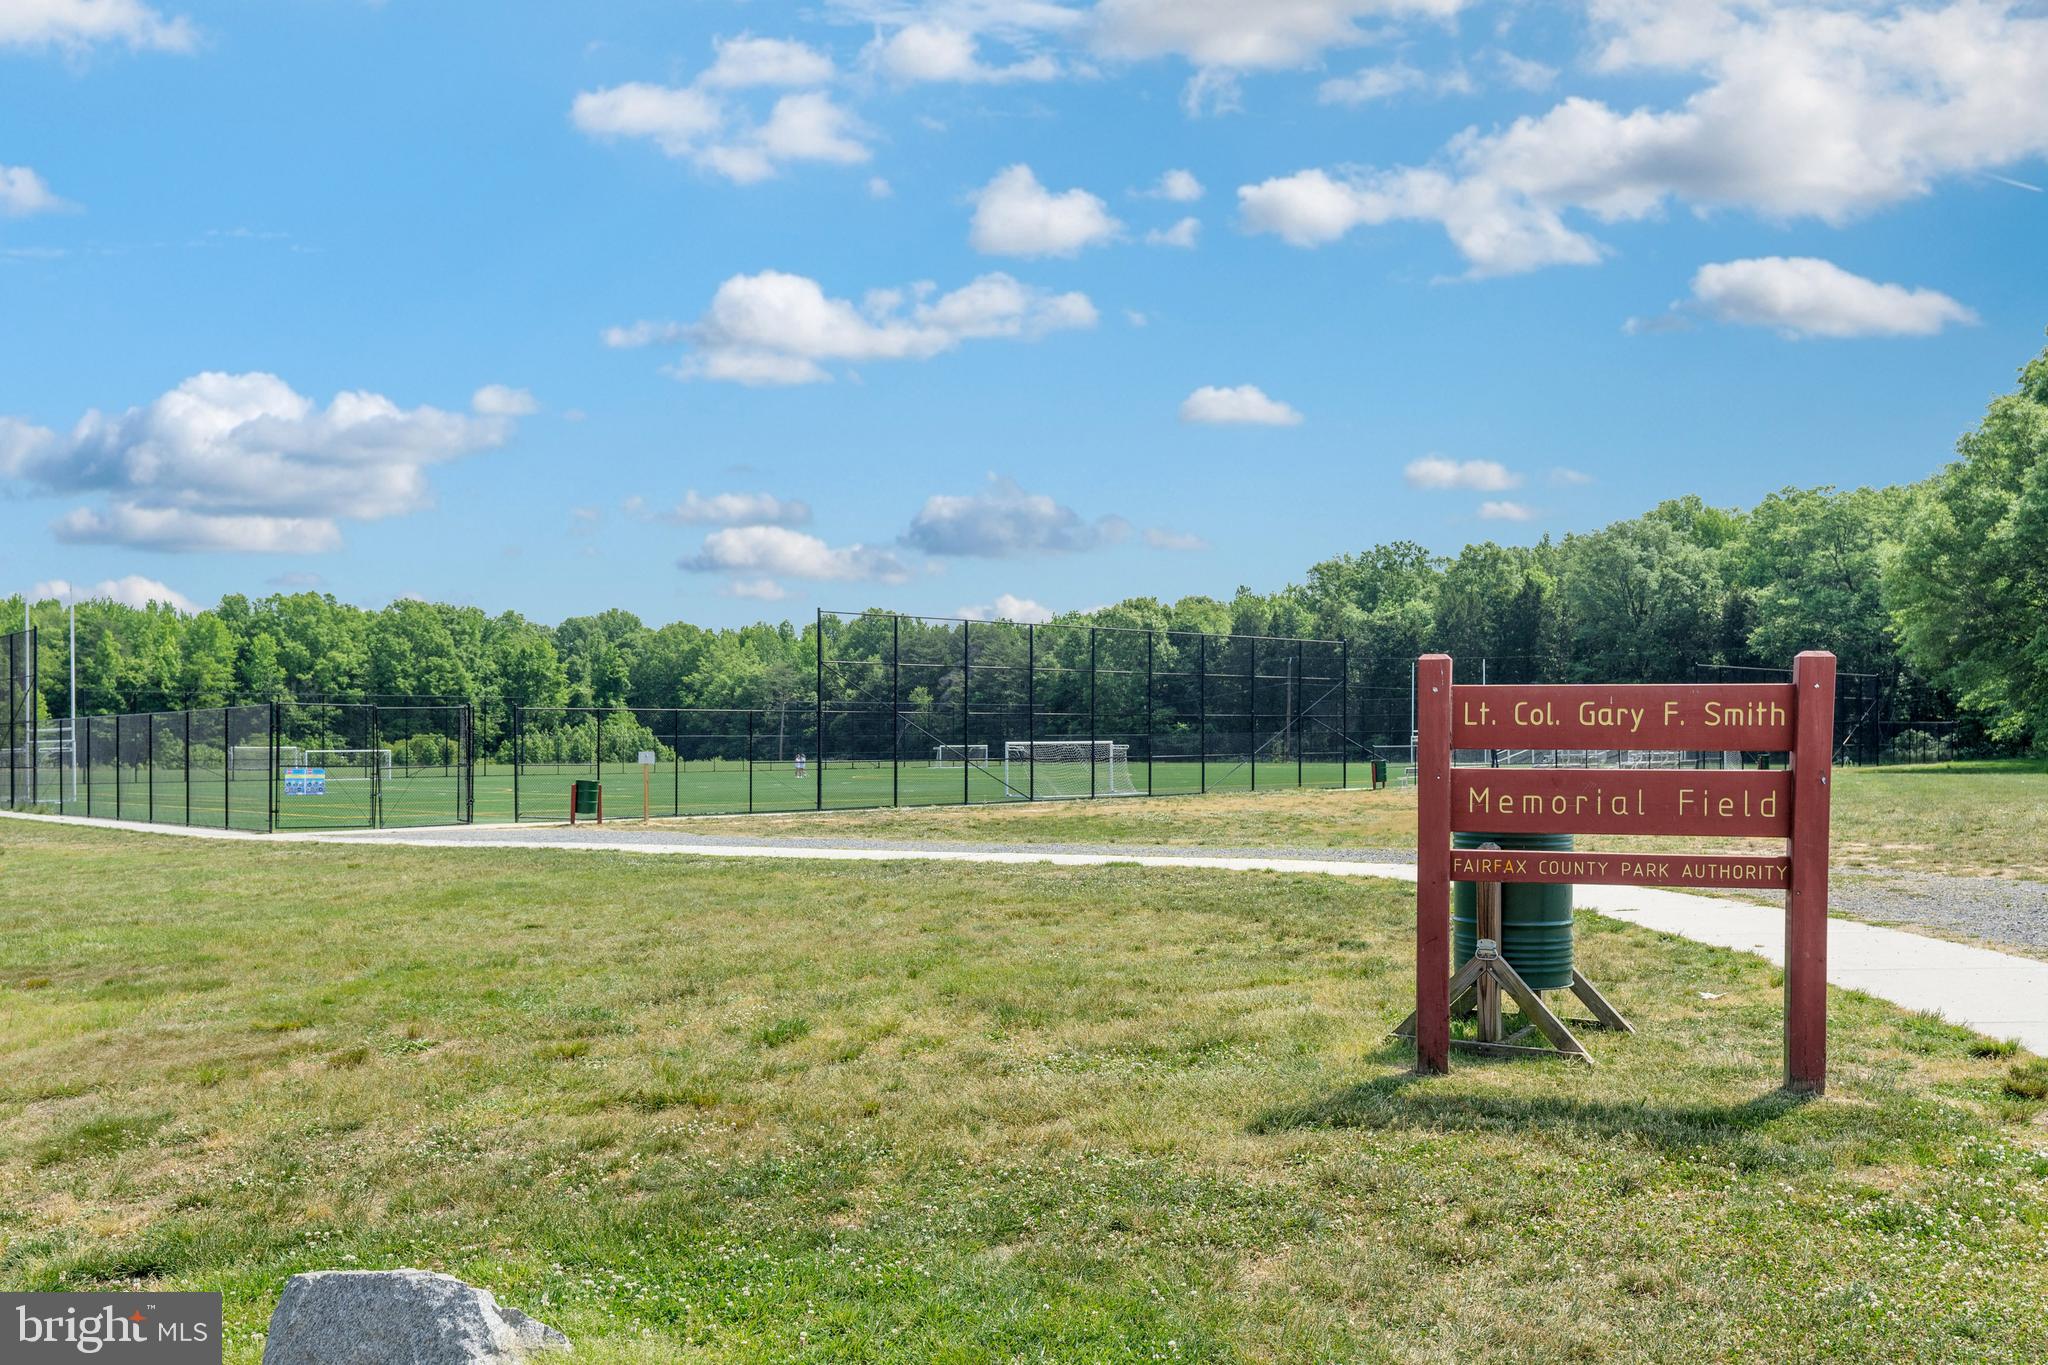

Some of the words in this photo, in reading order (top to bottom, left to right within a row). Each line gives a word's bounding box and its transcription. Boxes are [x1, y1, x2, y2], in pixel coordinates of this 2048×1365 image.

[1463, 701, 1496, 727] Lt.
[1514, 701, 1560, 727] Col.
[1578, 701, 1645, 733] Gary
[1664, 702, 1685, 727] F.
[1704, 701, 1786, 728] Smith
[1468, 786, 1645, 816] Memorial
[1679, 789, 1777, 819] Field
[1453, 857, 1527, 875] FAIRFAX
[1538, 859, 1609, 877] COUNTY
[1620, 862, 1669, 879] PARK
[1681, 863, 1788, 881] AUTHORITY
